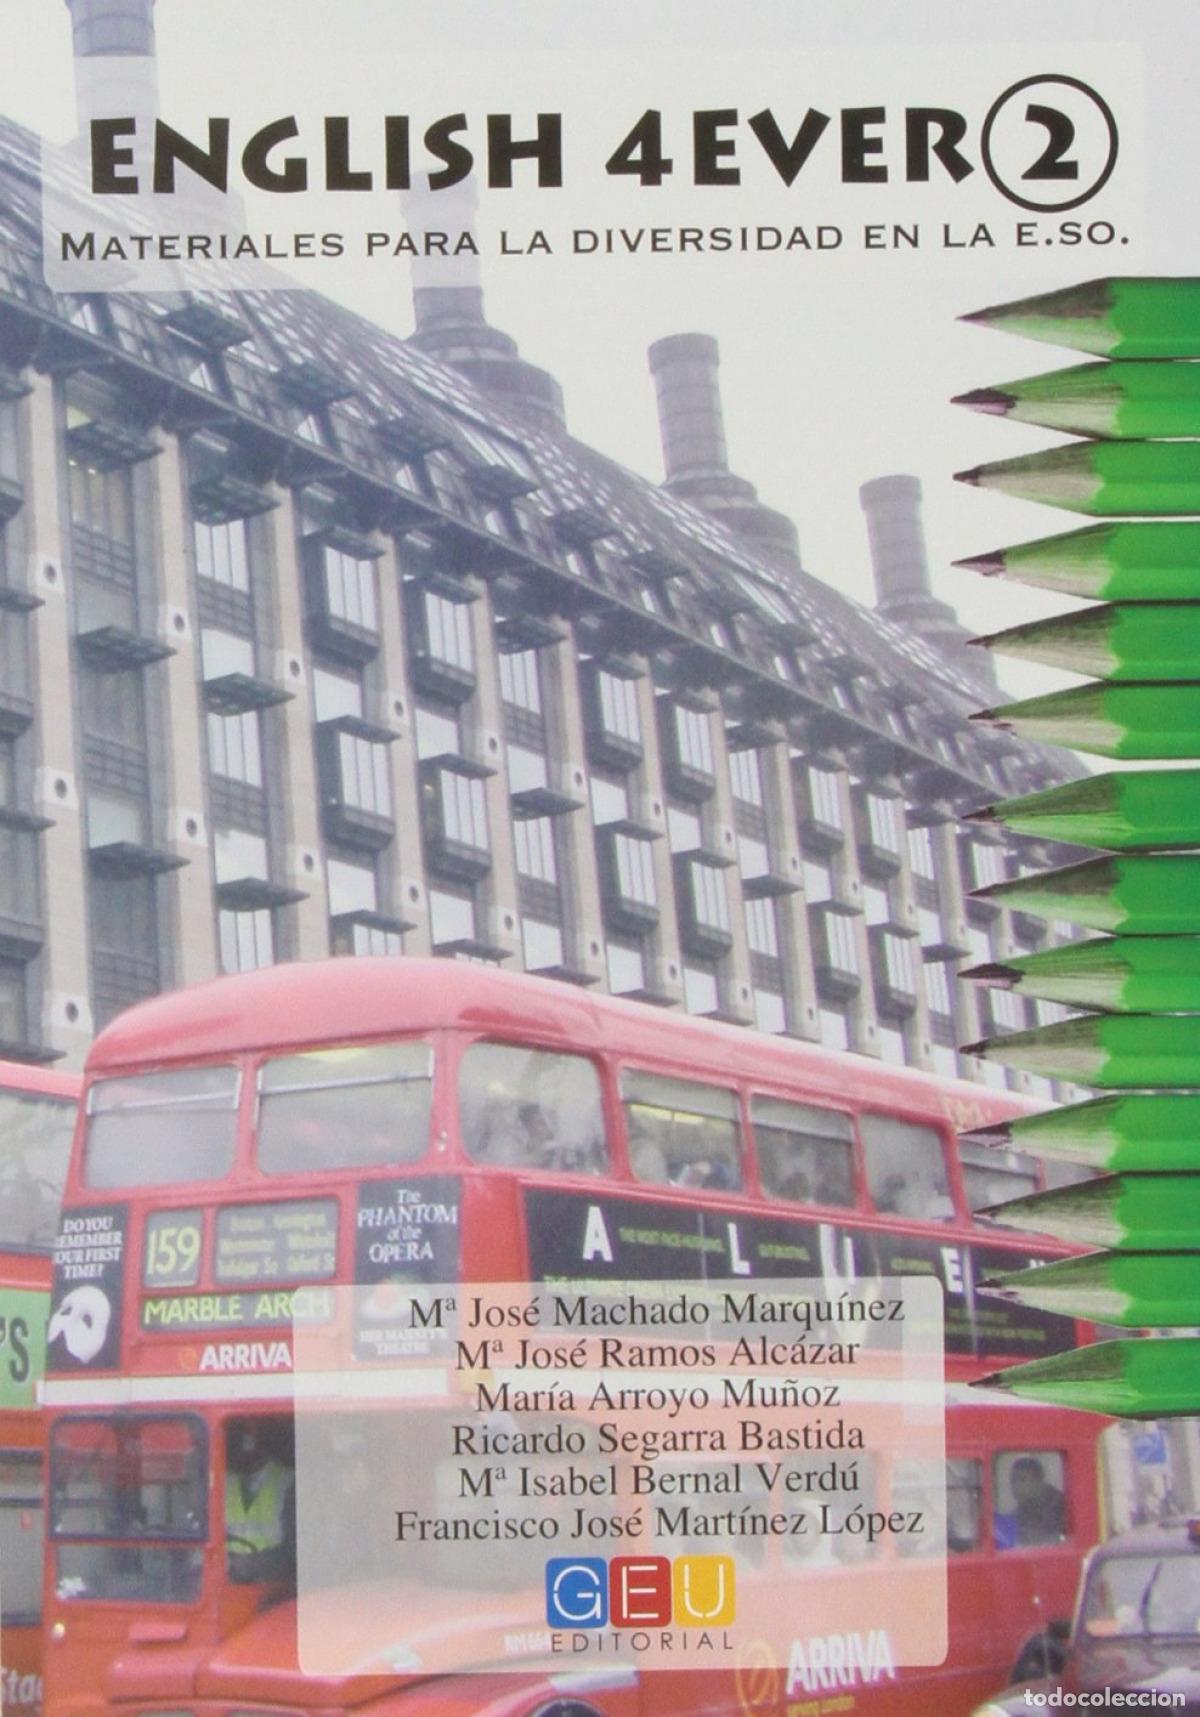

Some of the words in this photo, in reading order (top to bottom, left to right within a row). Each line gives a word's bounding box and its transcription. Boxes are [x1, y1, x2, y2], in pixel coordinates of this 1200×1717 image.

[91, 112, 562, 194] ENGLISH
[605, 106, 975, 187] 4EVER
[1020, 103, 1079, 181] 2
[61, 233, 345, 261] MATERIALES
[366, 231, 480, 257] PARA
[499, 229, 552, 255] LA
[572, 225, 843, 255] DIVERSIDAD
[863, 224, 919, 249] EN
[942, 222, 996, 248] LA
[1015, 220, 1130, 248] E.SO.
[397, 1189, 421, 1204] The
[63, 1218, 84, 1234] DO
[85, 1215, 114, 1232] YOU
[358, 1203, 458, 1228] PHANTOM
[55, 1231, 123, 1249] EMEMBER
[55, 1249, 84, 1265] OUR
[85, 1246, 122, 1262] FIRST
[147, 1226, 201, 1276] 159
[369, 1241, 434, 1264] OPERA
[144, 1294, 244, 1326] MARBLE
[253, 1288, 329, 1320] ARCH
[468, 1296, 541, 1328] José
[551, 1294, 710, 1327] Machado
[721, 1291, 906, 1332] Marquínez
[199, 1342, 293, 1371] ARRIVA
[515, 1337, 588, 1370] José
[599, 1337, 716, 1370] Ramos
[728, 1334, 860, 1366] Alcázar
[475, 1381, 577, 1413] María
[587, 1379, 710, 1419] Arroyo
[721, 1378, 841, 1409] Muñoz
[451, 1423, 586, 1457] Ricardo
[597, 1421, 727, 1462] Segarra
[737, 1418, 866, 1451] Bastida
[518, 1464, 618, 1497] Isabel
[631, 1462, 743, 1495] Bernal
[755, 1460, 860, 1493] Verdú
[393, 1508, 559, 1542] Francisco
[570, 1506, 643, 1540] José
[655, 1504, 808, 1538] Martínez
[817, 1502, 926, 1543] López
[551, 1630, 735, 1654] EDITORIAL
[785, 1628, 897, 1696] ARRIVA
